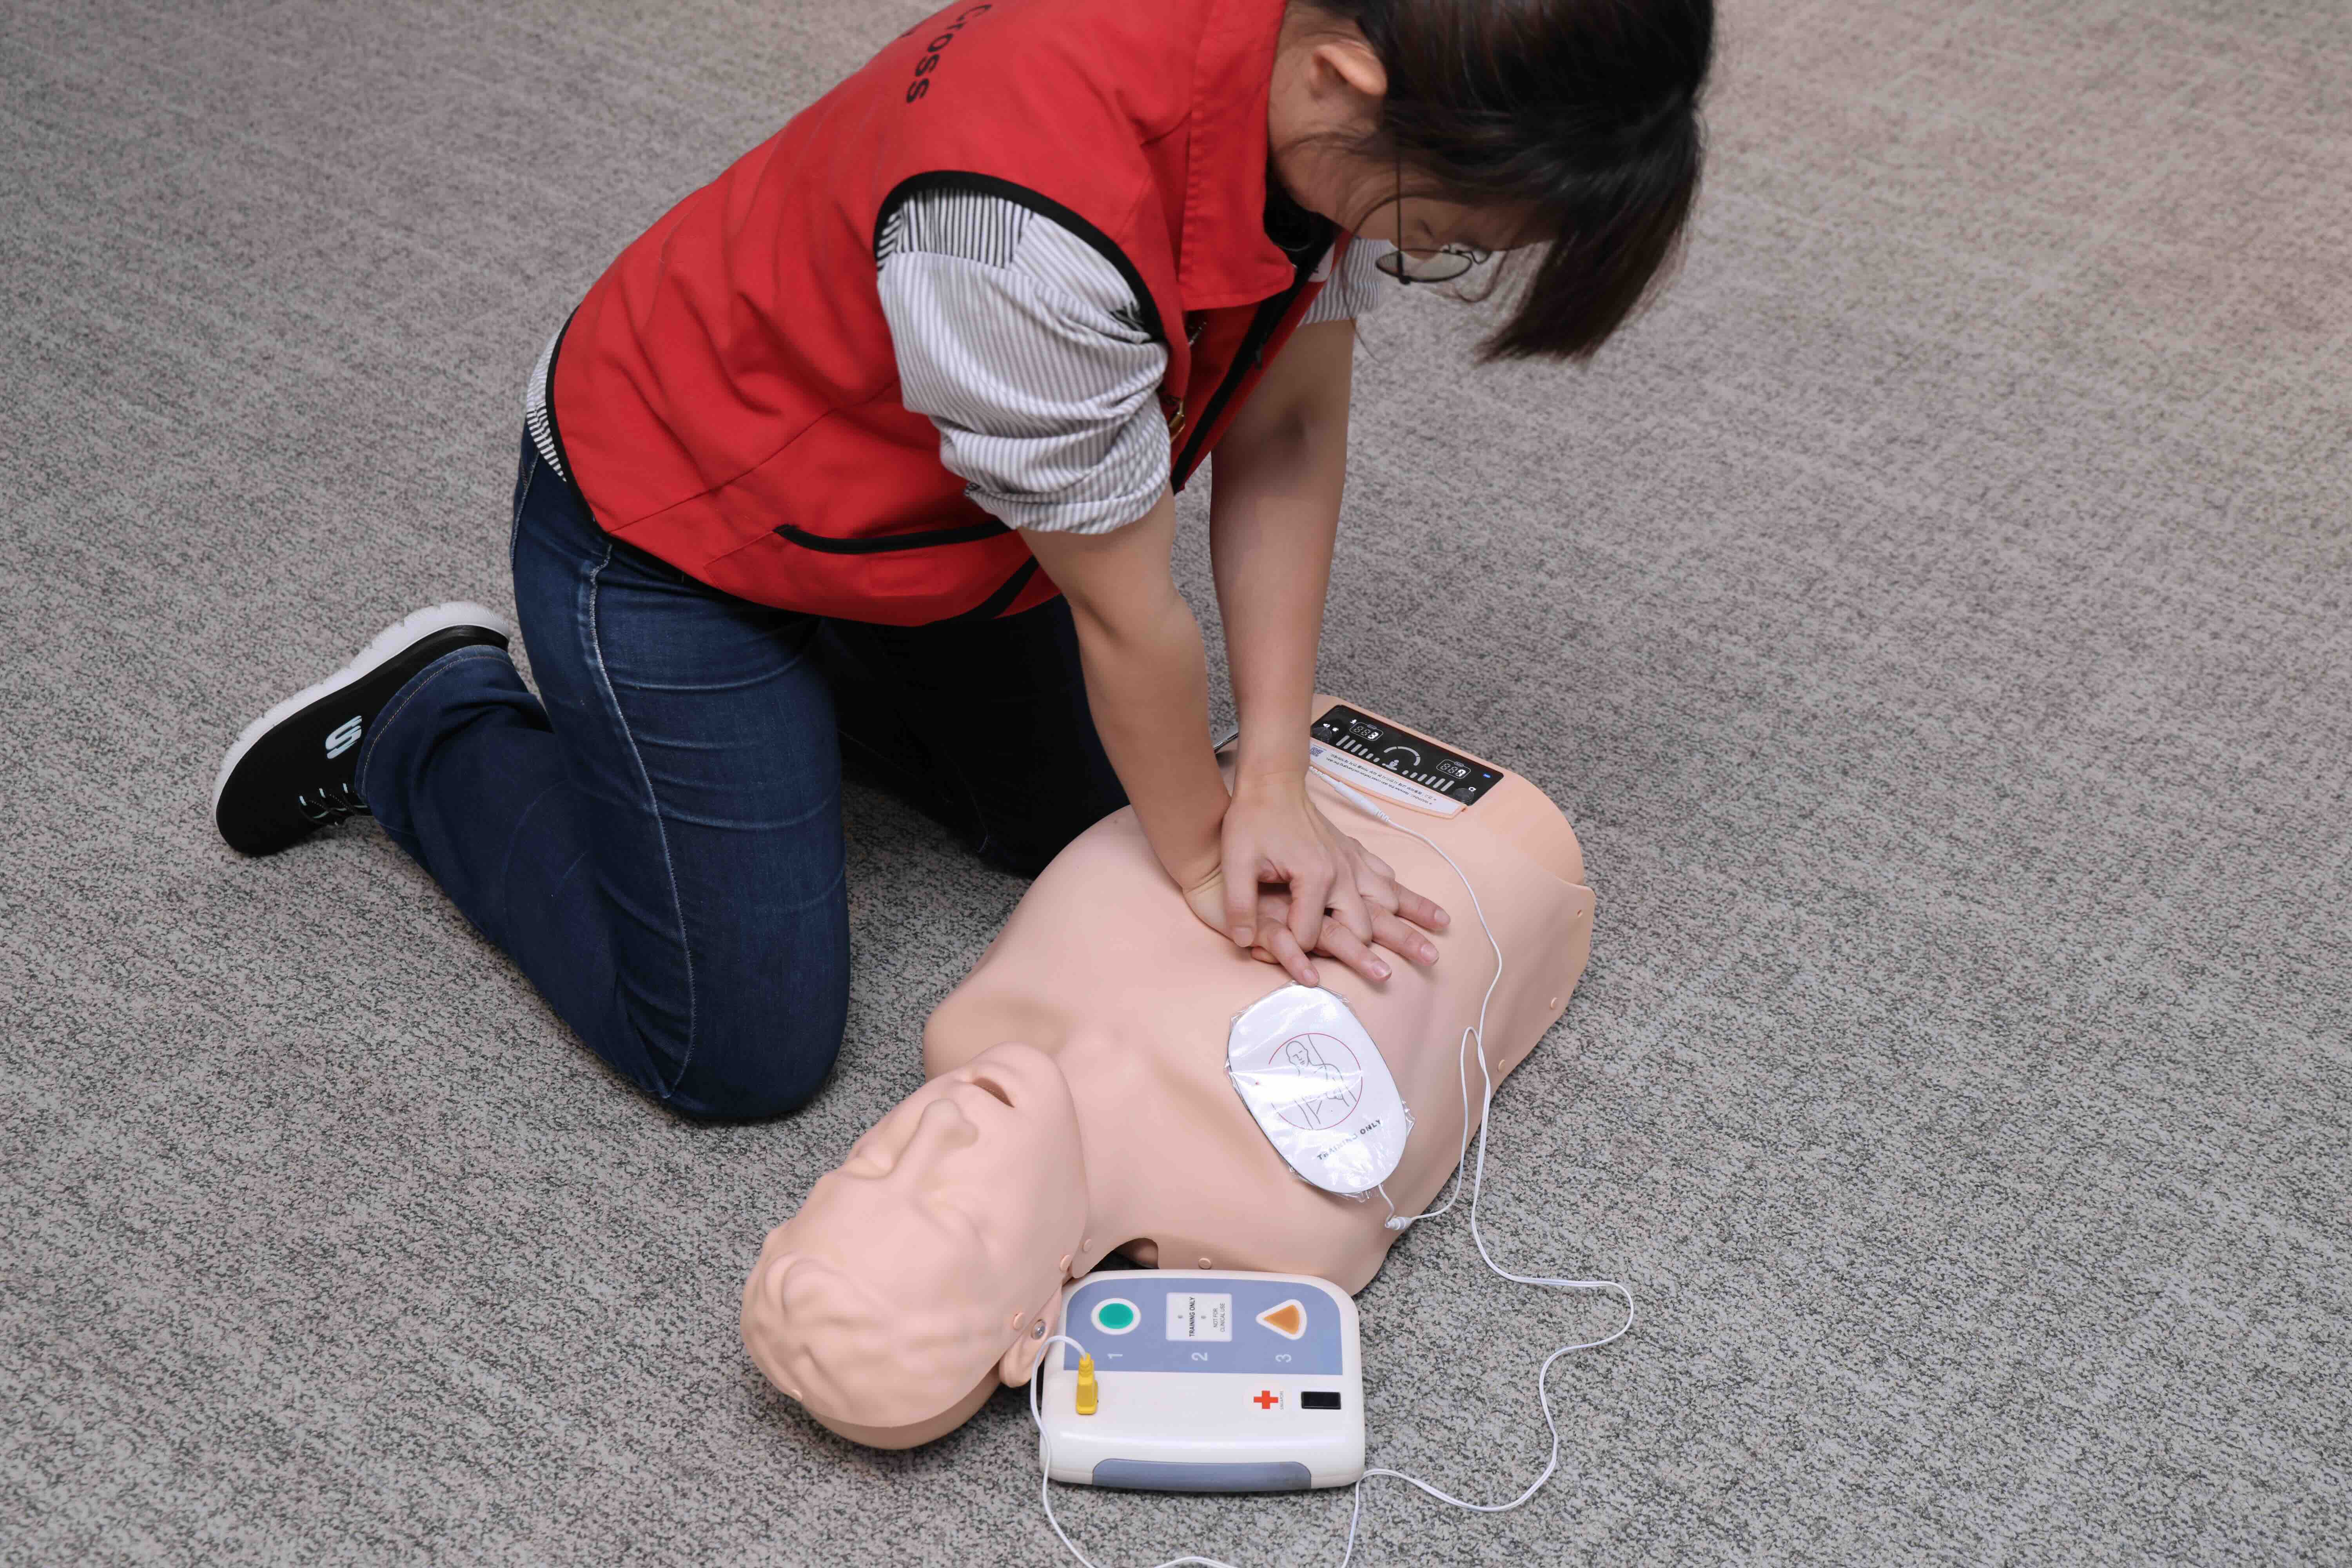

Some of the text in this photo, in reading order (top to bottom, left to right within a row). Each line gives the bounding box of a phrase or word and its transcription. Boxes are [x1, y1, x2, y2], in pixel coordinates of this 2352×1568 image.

[1360, 1119, 1381, 1134] ONLY
[1191, 1352, 1208, 1361] 2
[1275, 1354, 1292, 1362] 3
